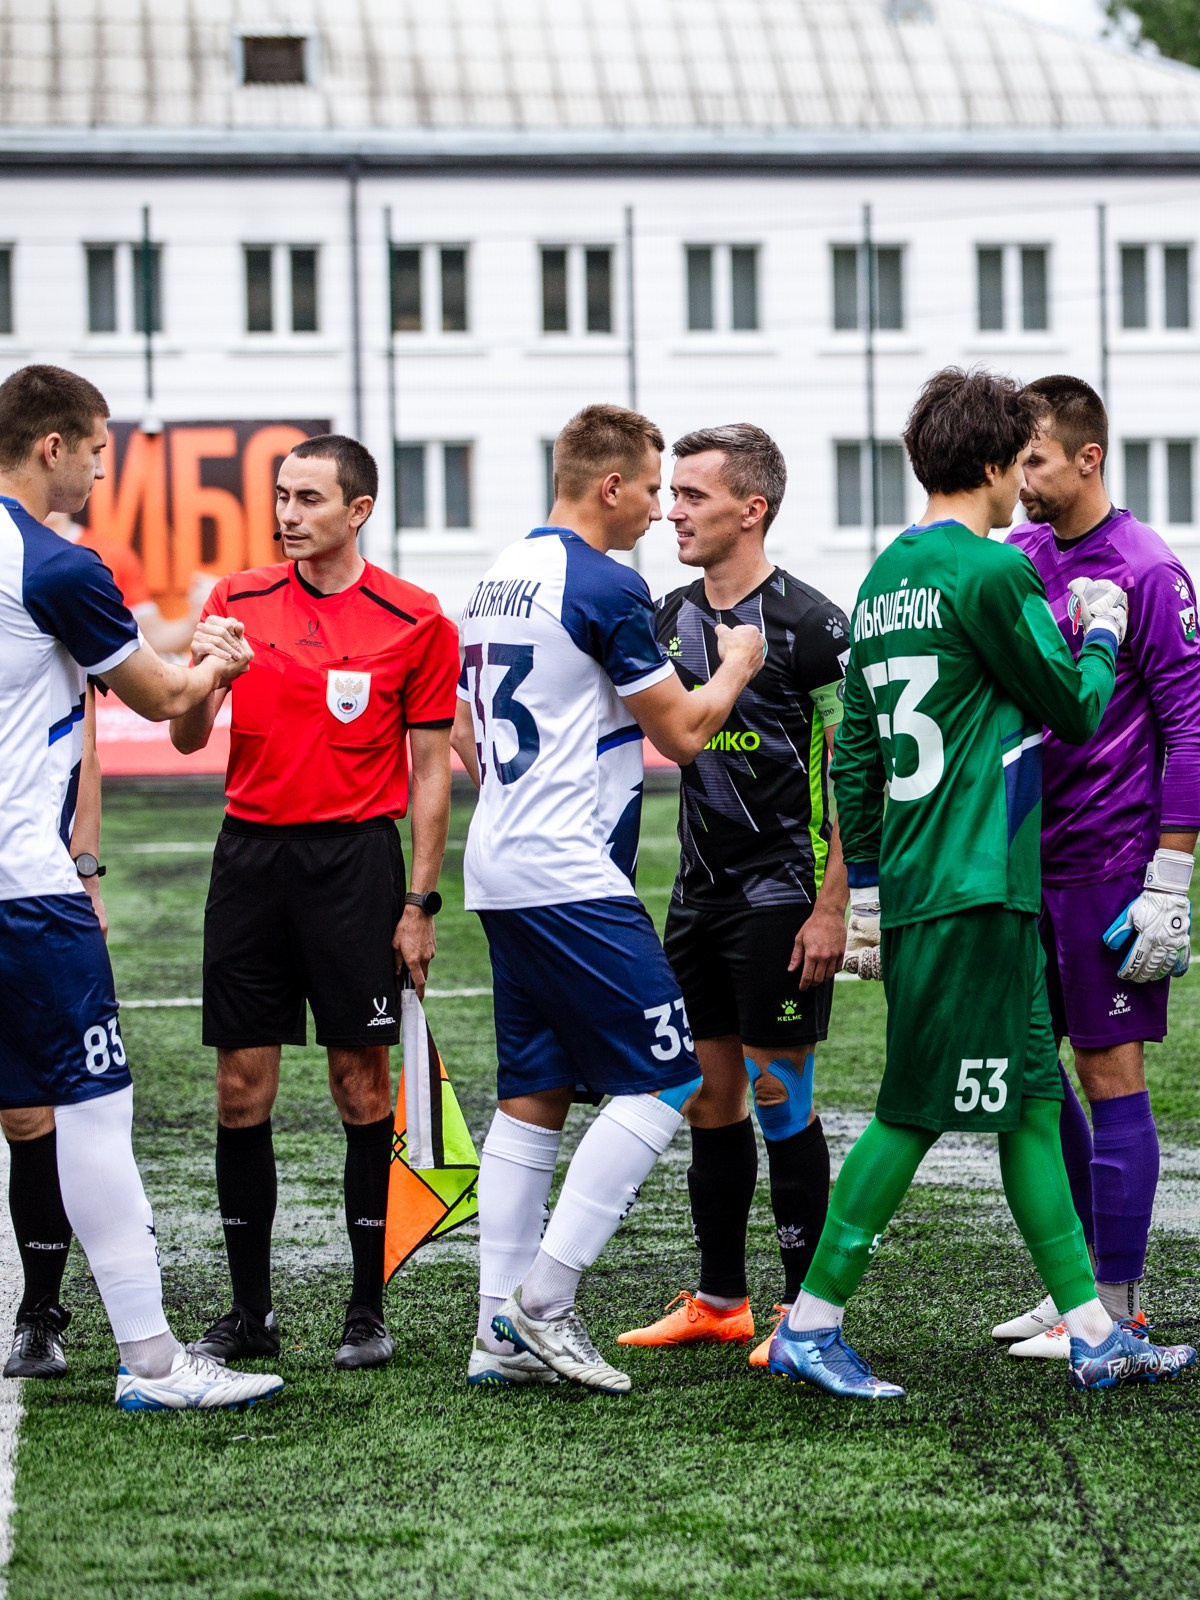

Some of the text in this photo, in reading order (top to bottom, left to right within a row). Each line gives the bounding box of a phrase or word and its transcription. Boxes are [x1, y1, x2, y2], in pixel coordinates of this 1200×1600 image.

[1108, 1006, 1132, 1017] KELME
[367, 1016, 396, 1027] JÖGEL
[777, 1014, 803, 1022] KELME
[643, 996, 695, 1062] 33
[83, 1016, 127, 1075] 83
[954, 1057, 1009, 1113] 53
[222, 1217, 249, 1226] GEL
[354, 1217, 386, 1227] JÖGE
[25, 1241, 68, 1250] JÖGEL
[867, 1233, 883, 1255] 5
